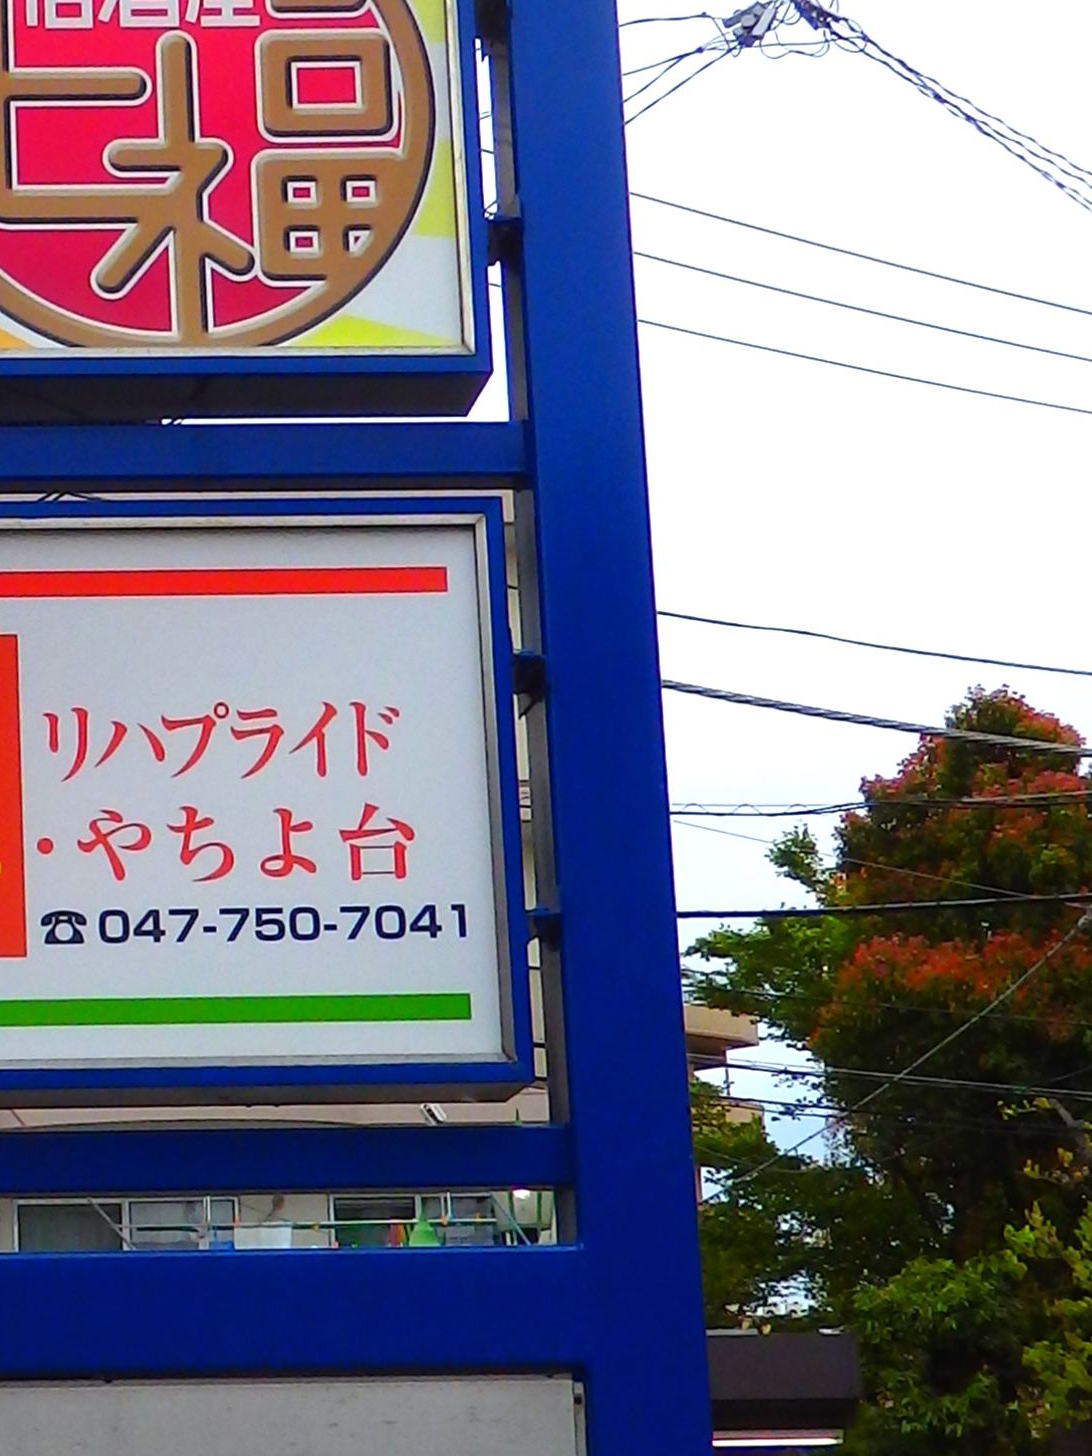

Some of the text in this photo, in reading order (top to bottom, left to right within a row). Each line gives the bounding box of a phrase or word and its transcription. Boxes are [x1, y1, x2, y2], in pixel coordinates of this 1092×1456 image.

[42, 700, 401, 783] リハプライド
[98, 903, 470, 946] 047-750-7041
